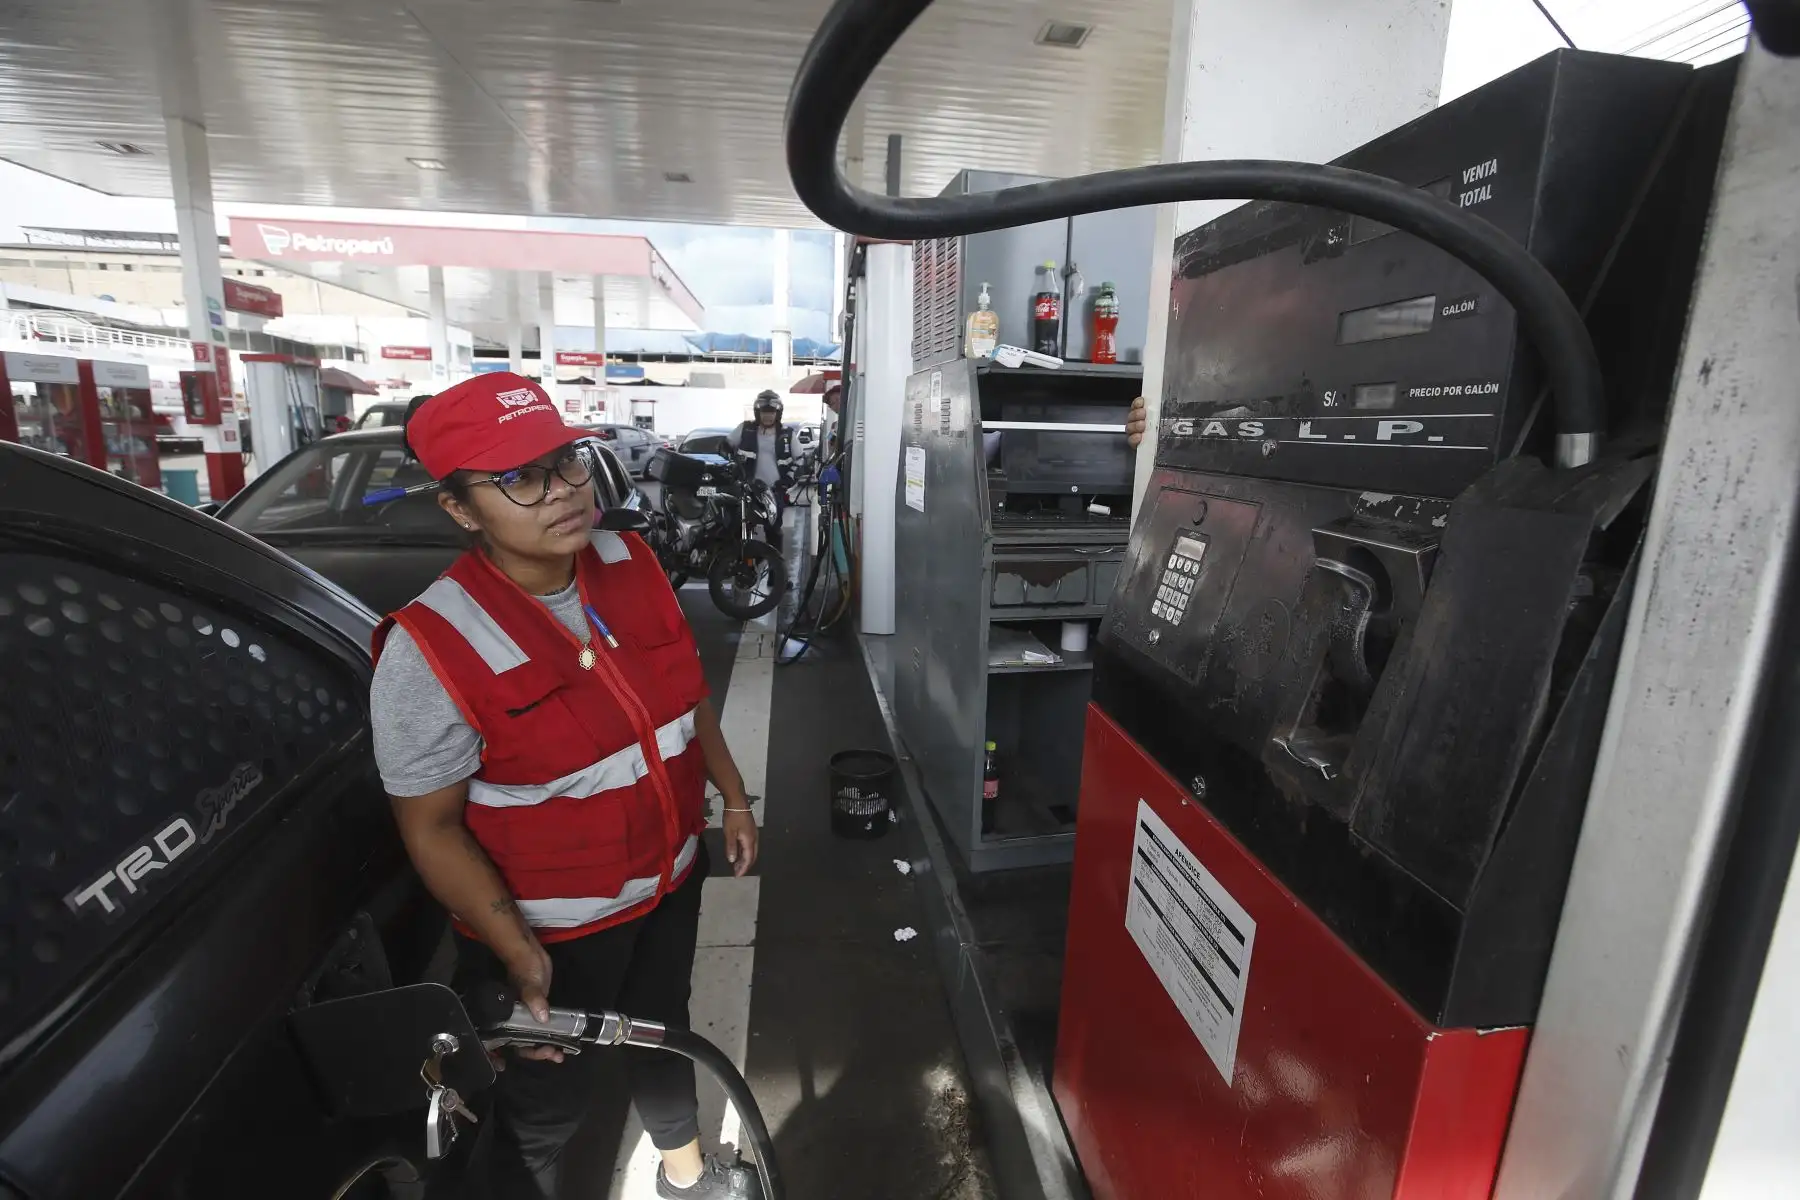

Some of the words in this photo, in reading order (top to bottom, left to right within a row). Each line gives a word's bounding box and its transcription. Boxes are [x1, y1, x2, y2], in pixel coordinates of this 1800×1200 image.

[1463, 159, 1497, 185] VENTA
[1460, 184, 1492, 208] TOTAL
[291, 232, 395, 257] Petroperú
[1442, 300, 1476, 316] GALÓN
[1323, 391, 1338, 407] S/.
[1409, 387, 1441, 398] PRECIO
[1443, 386, 1462, 396] POR
[1464, 382, 1500, 395] GALÓN
[1171, 421, 1265, 438] GAS
[74, 818, 197, 913] TRD
